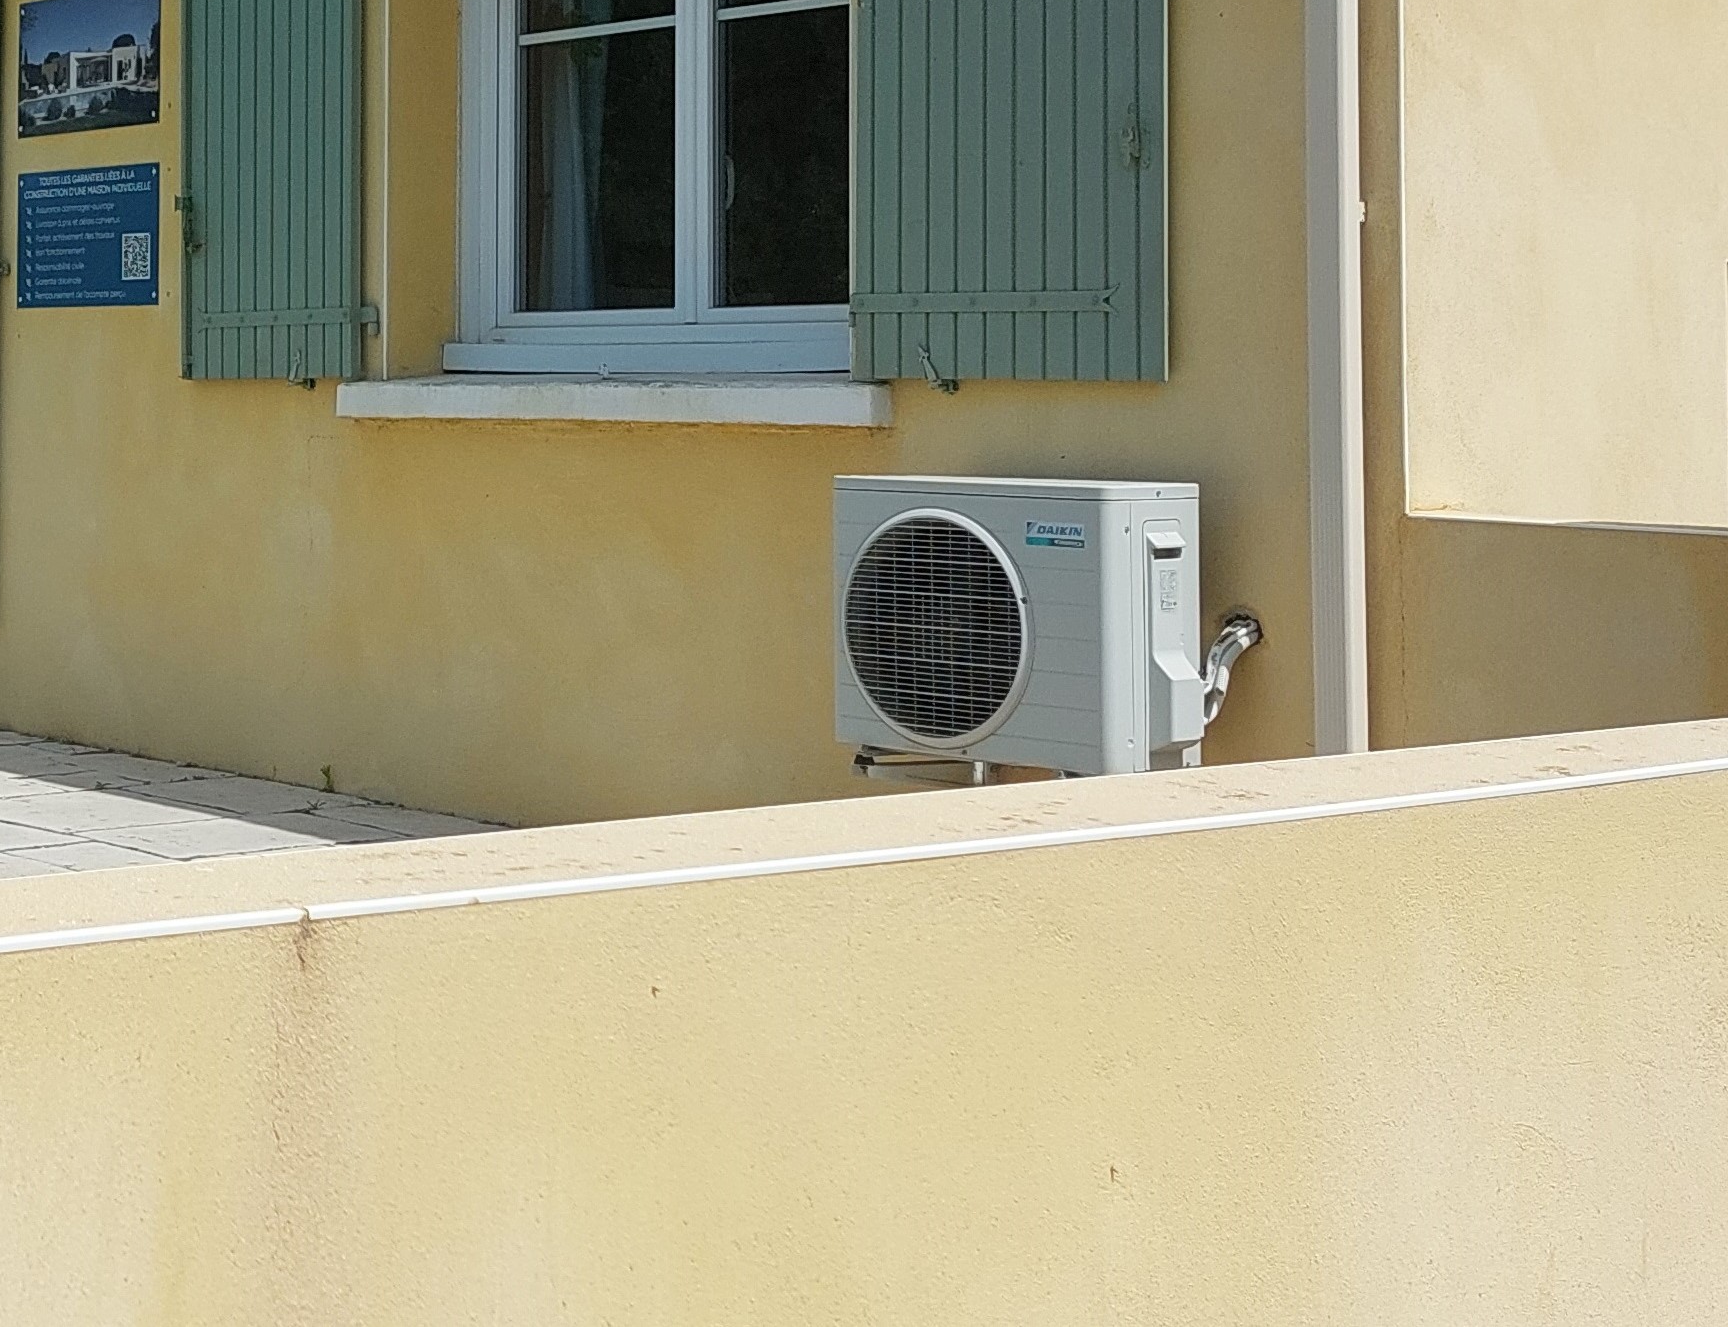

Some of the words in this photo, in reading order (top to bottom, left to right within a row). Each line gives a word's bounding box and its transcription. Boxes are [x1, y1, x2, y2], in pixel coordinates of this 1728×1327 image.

[39, 175, 60, 186] TOUTES
[60, 174, 71, 185] LES
[72, 172, 104, 183] GARANTIES
[127, 170, 135, 179] LA
[24, 188, 68, 200] CONSTRUCTION
[87, 184, 110, 195] MAISON
[111, 181, 151, 193] INDIVIDUELLE
[1037, 525, 1083, 537] DAIKIN
